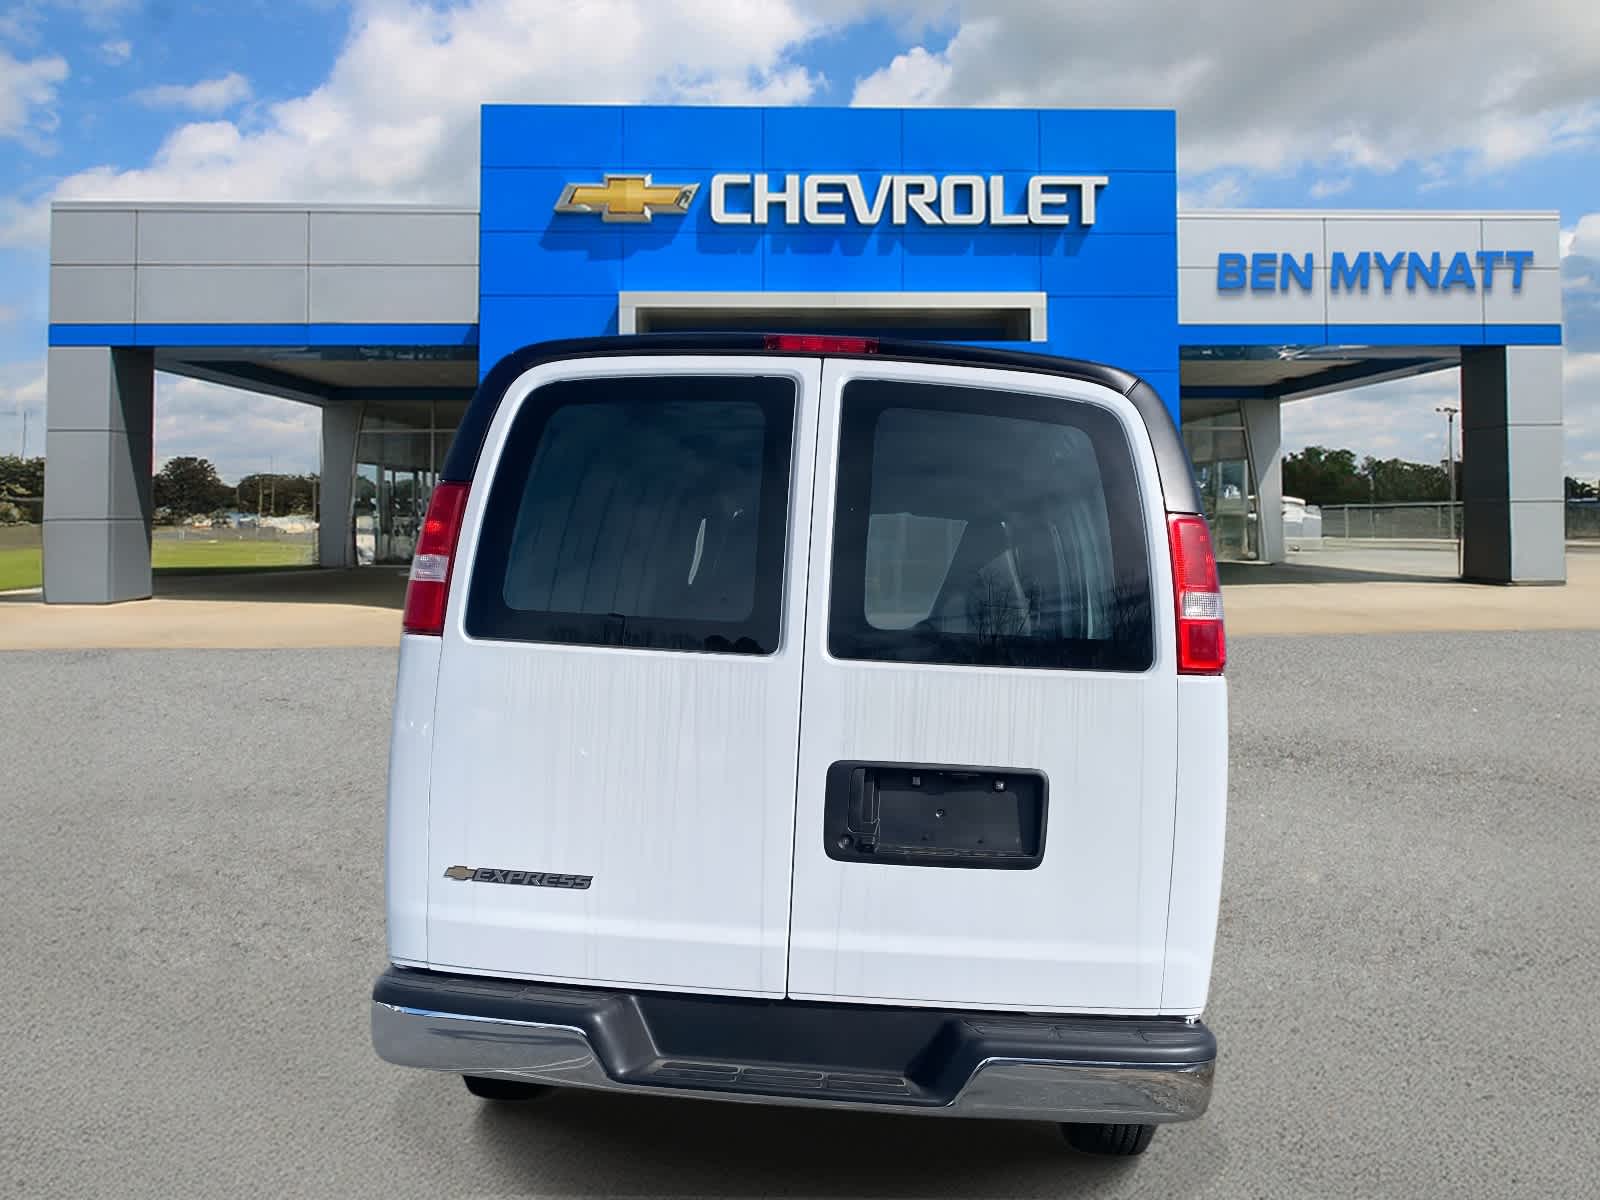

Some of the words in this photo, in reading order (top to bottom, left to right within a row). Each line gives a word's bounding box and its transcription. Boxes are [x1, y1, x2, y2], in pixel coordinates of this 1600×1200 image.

[711, 173, 1109, 225] CHEVROLET
[1217, 252, 1313, 290] BEN
[1330, 251, 1534, 290] MYNATT
[474, 868, 592, 889] EXPRESS
